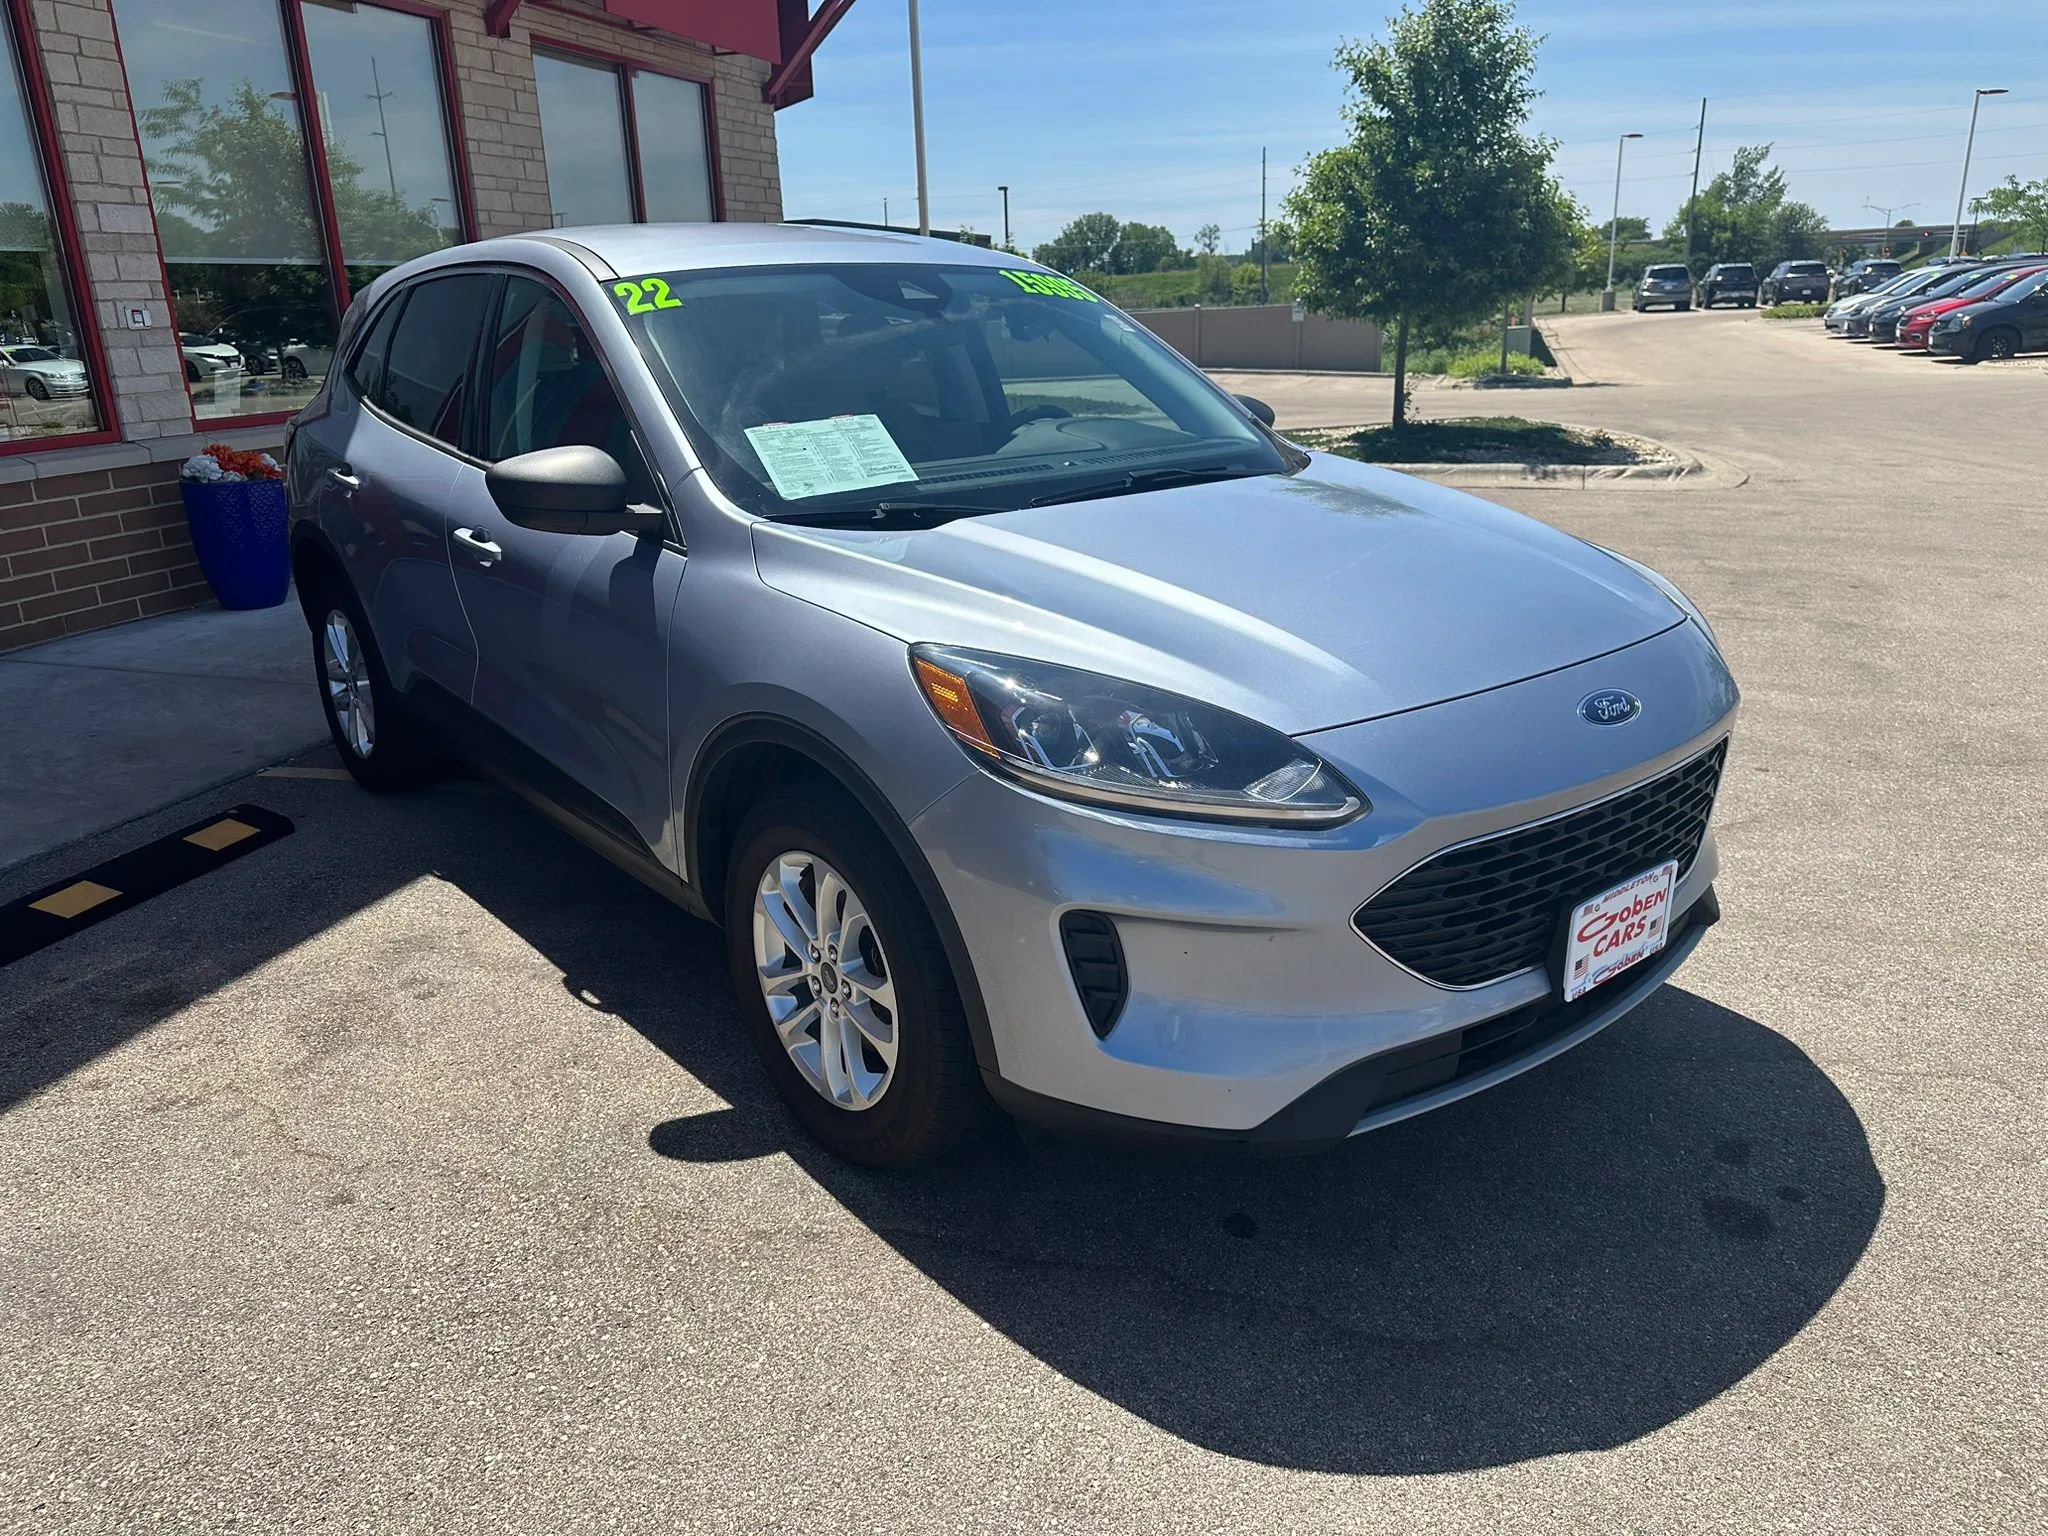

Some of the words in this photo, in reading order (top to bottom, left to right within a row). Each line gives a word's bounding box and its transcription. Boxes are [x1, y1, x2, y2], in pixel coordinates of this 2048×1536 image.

[613, 278, 683, 316] 22
[998, 269, 1099, 303] 15995
[1594, 695, 1631, 720] Ford
[1602, 872, 1655, 904] MIDDLETON
[1593, 915, 1647, 957] CARS
